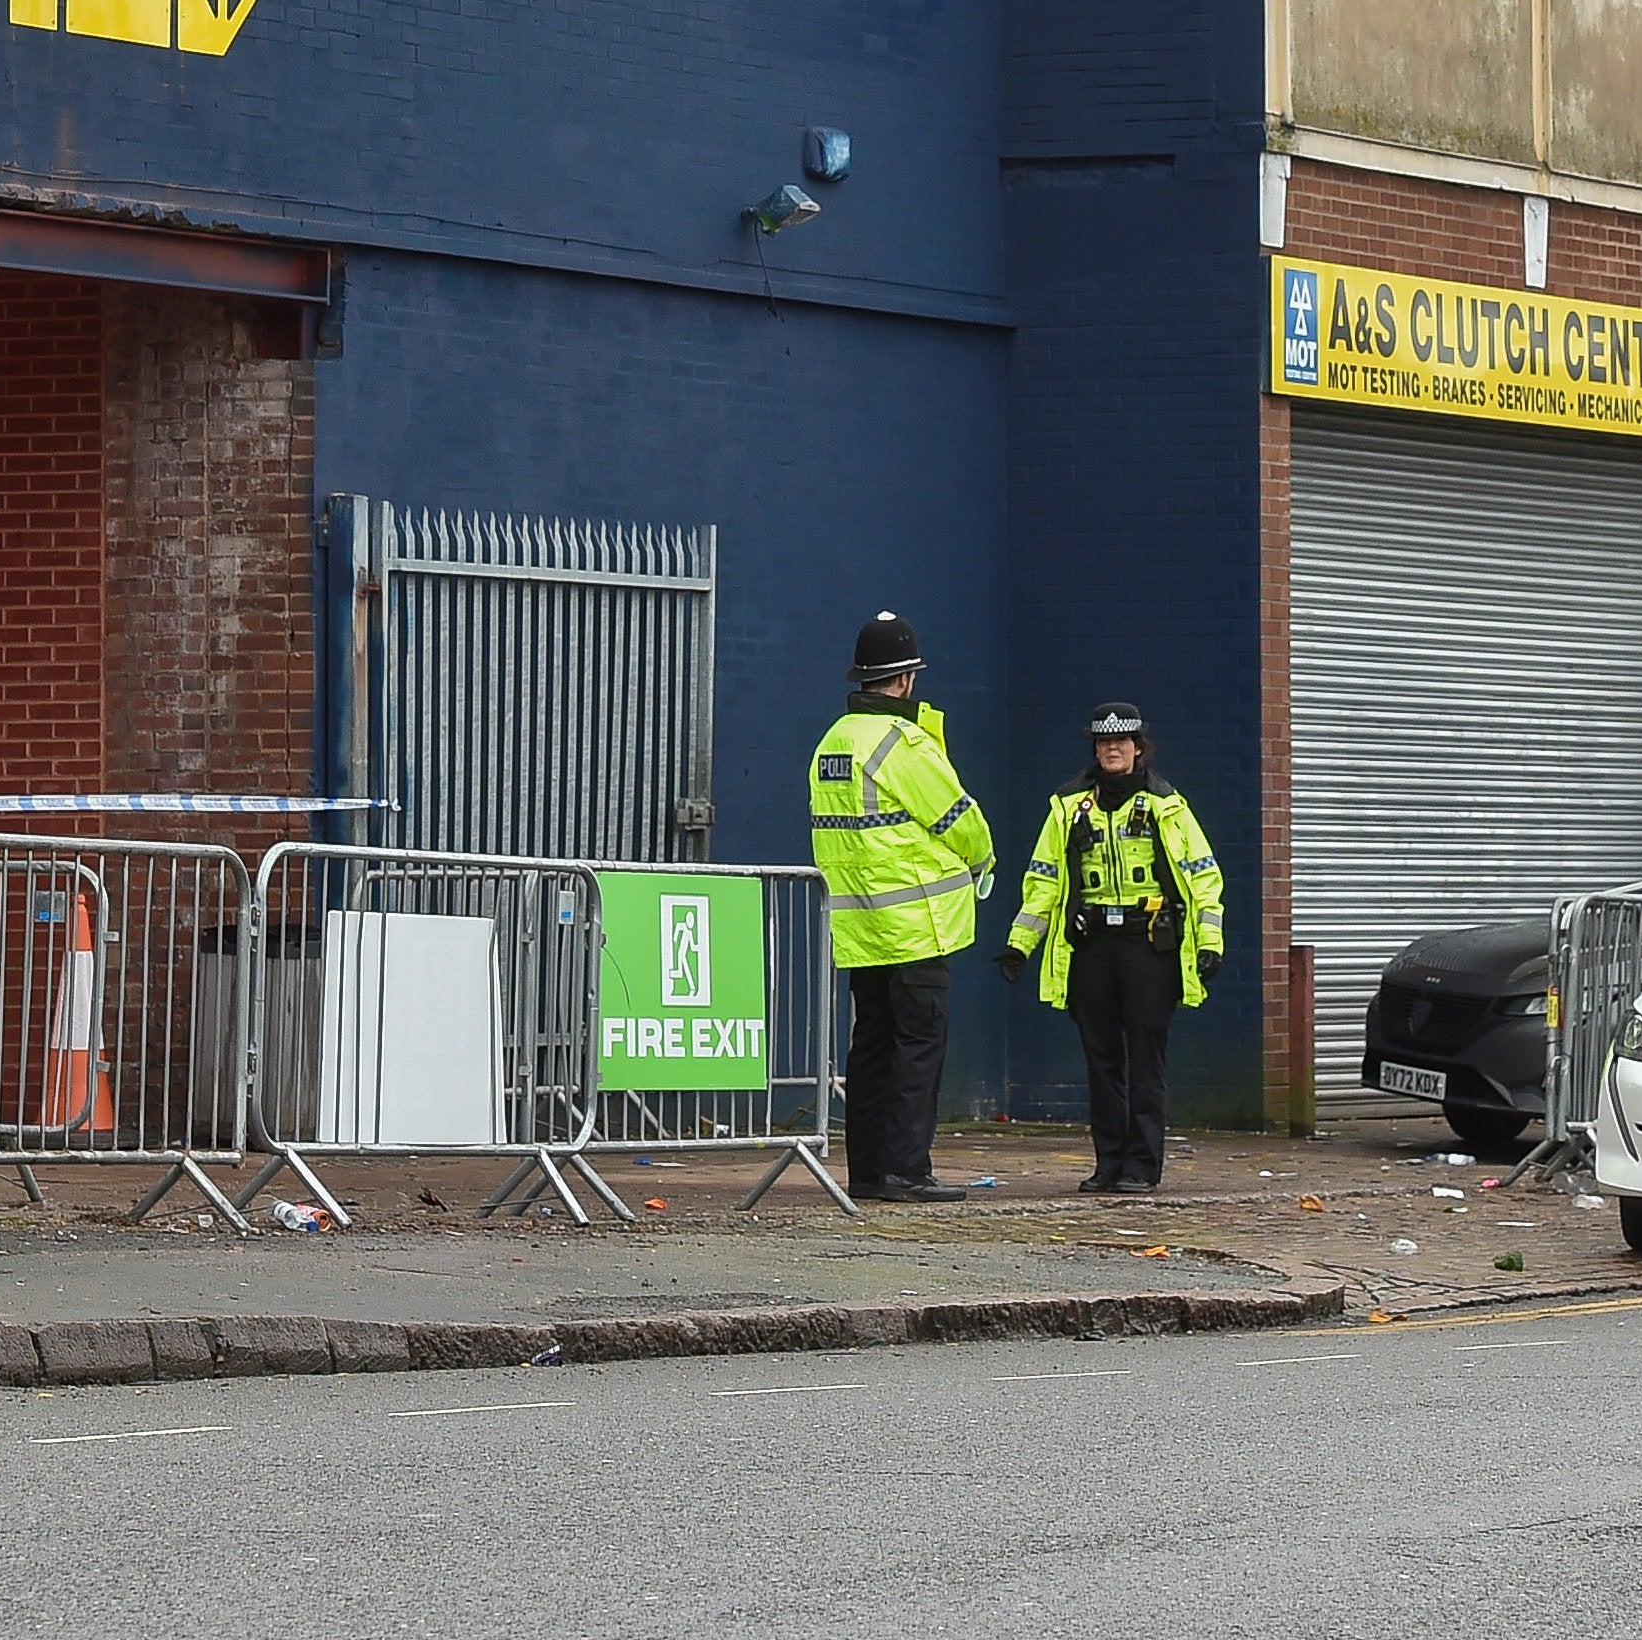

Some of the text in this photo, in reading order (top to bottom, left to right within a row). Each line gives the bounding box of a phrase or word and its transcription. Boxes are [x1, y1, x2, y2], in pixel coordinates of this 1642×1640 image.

[1328, 278, 1396, 357] A&S
[1410, 289, 1551, 375] CLUTCH
[1285, 338, 1317, 368] MOT
[1328, 361, 1357, 390] MOT
[1361, 366, 1420, 399] TESTING
[1432, 376, 1487, 407] BRAKES
[1496, 383, 1567, 414] SERVICING
[602, 1017, 765, 1059] FIRE EXIT
